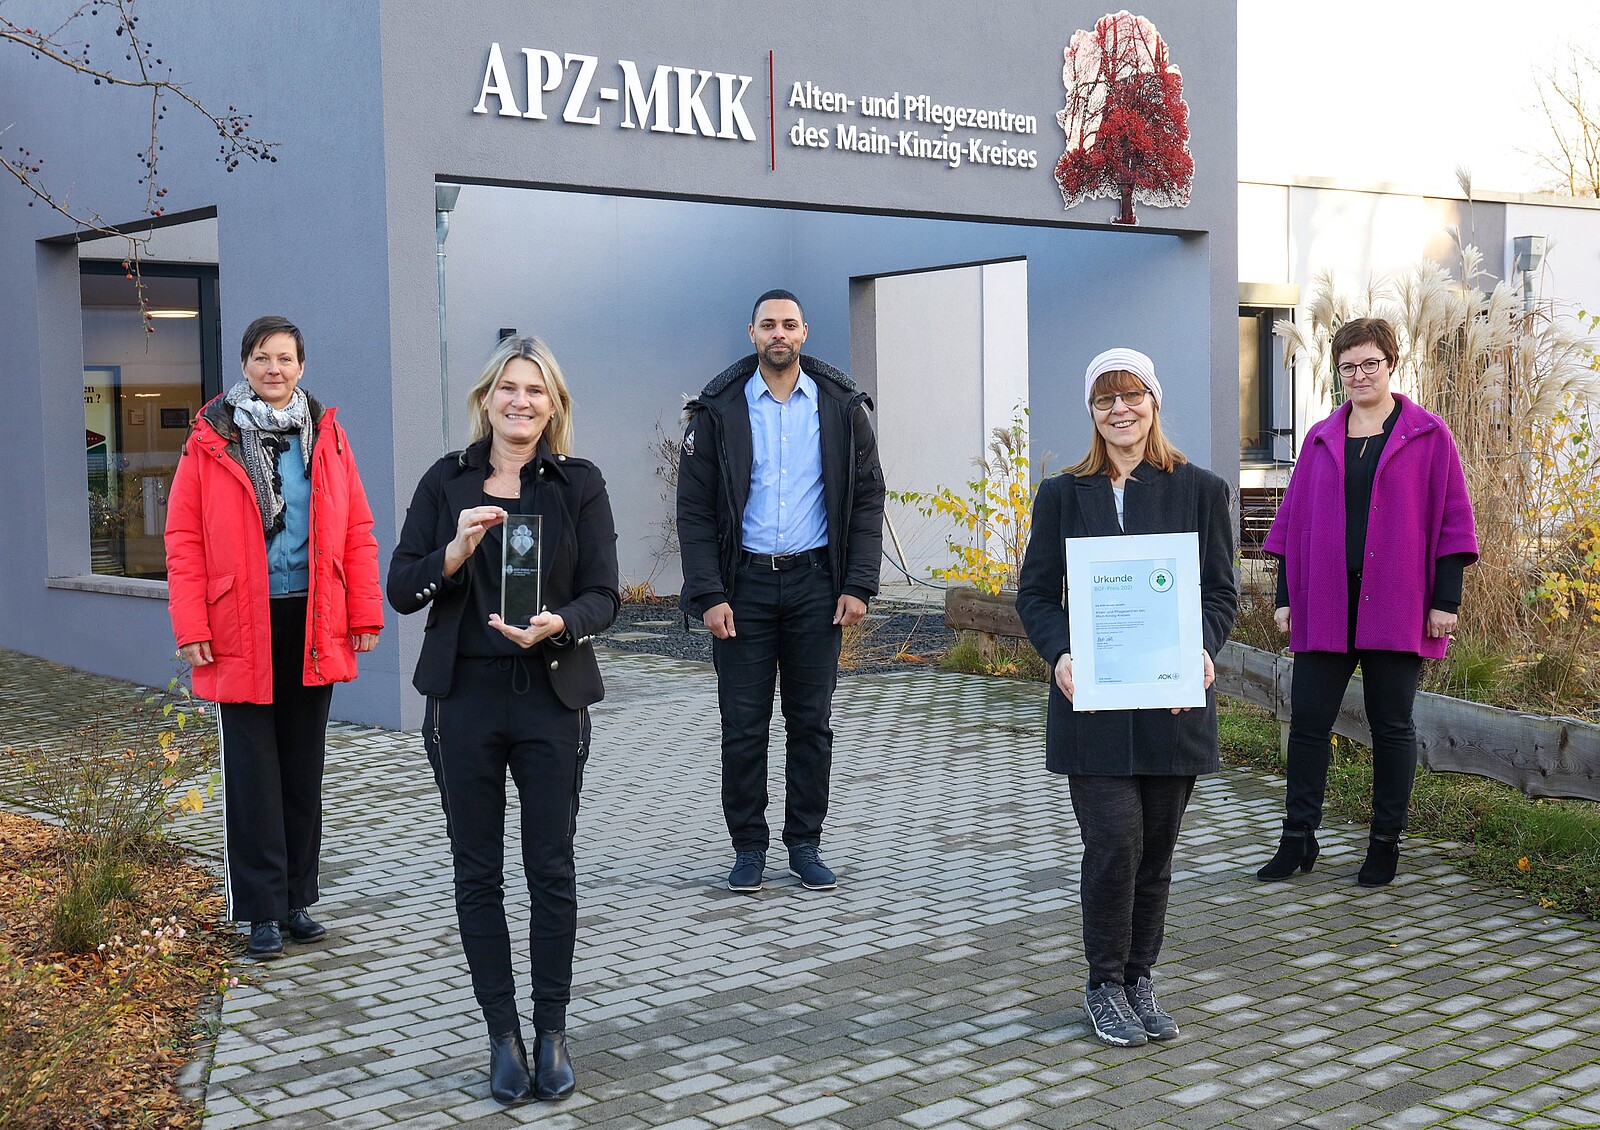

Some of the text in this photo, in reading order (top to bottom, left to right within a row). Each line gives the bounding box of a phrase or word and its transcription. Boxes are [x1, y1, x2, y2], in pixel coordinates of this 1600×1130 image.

[473, 42, 756, 141] APZ-MKK
[789, 81, 1038, 135] Alten- und Pflegezentren
[790, 124, 1038, 169] des Main-Kinzig-Kreises
[1093, 574, 1133, 584] Urkunde
